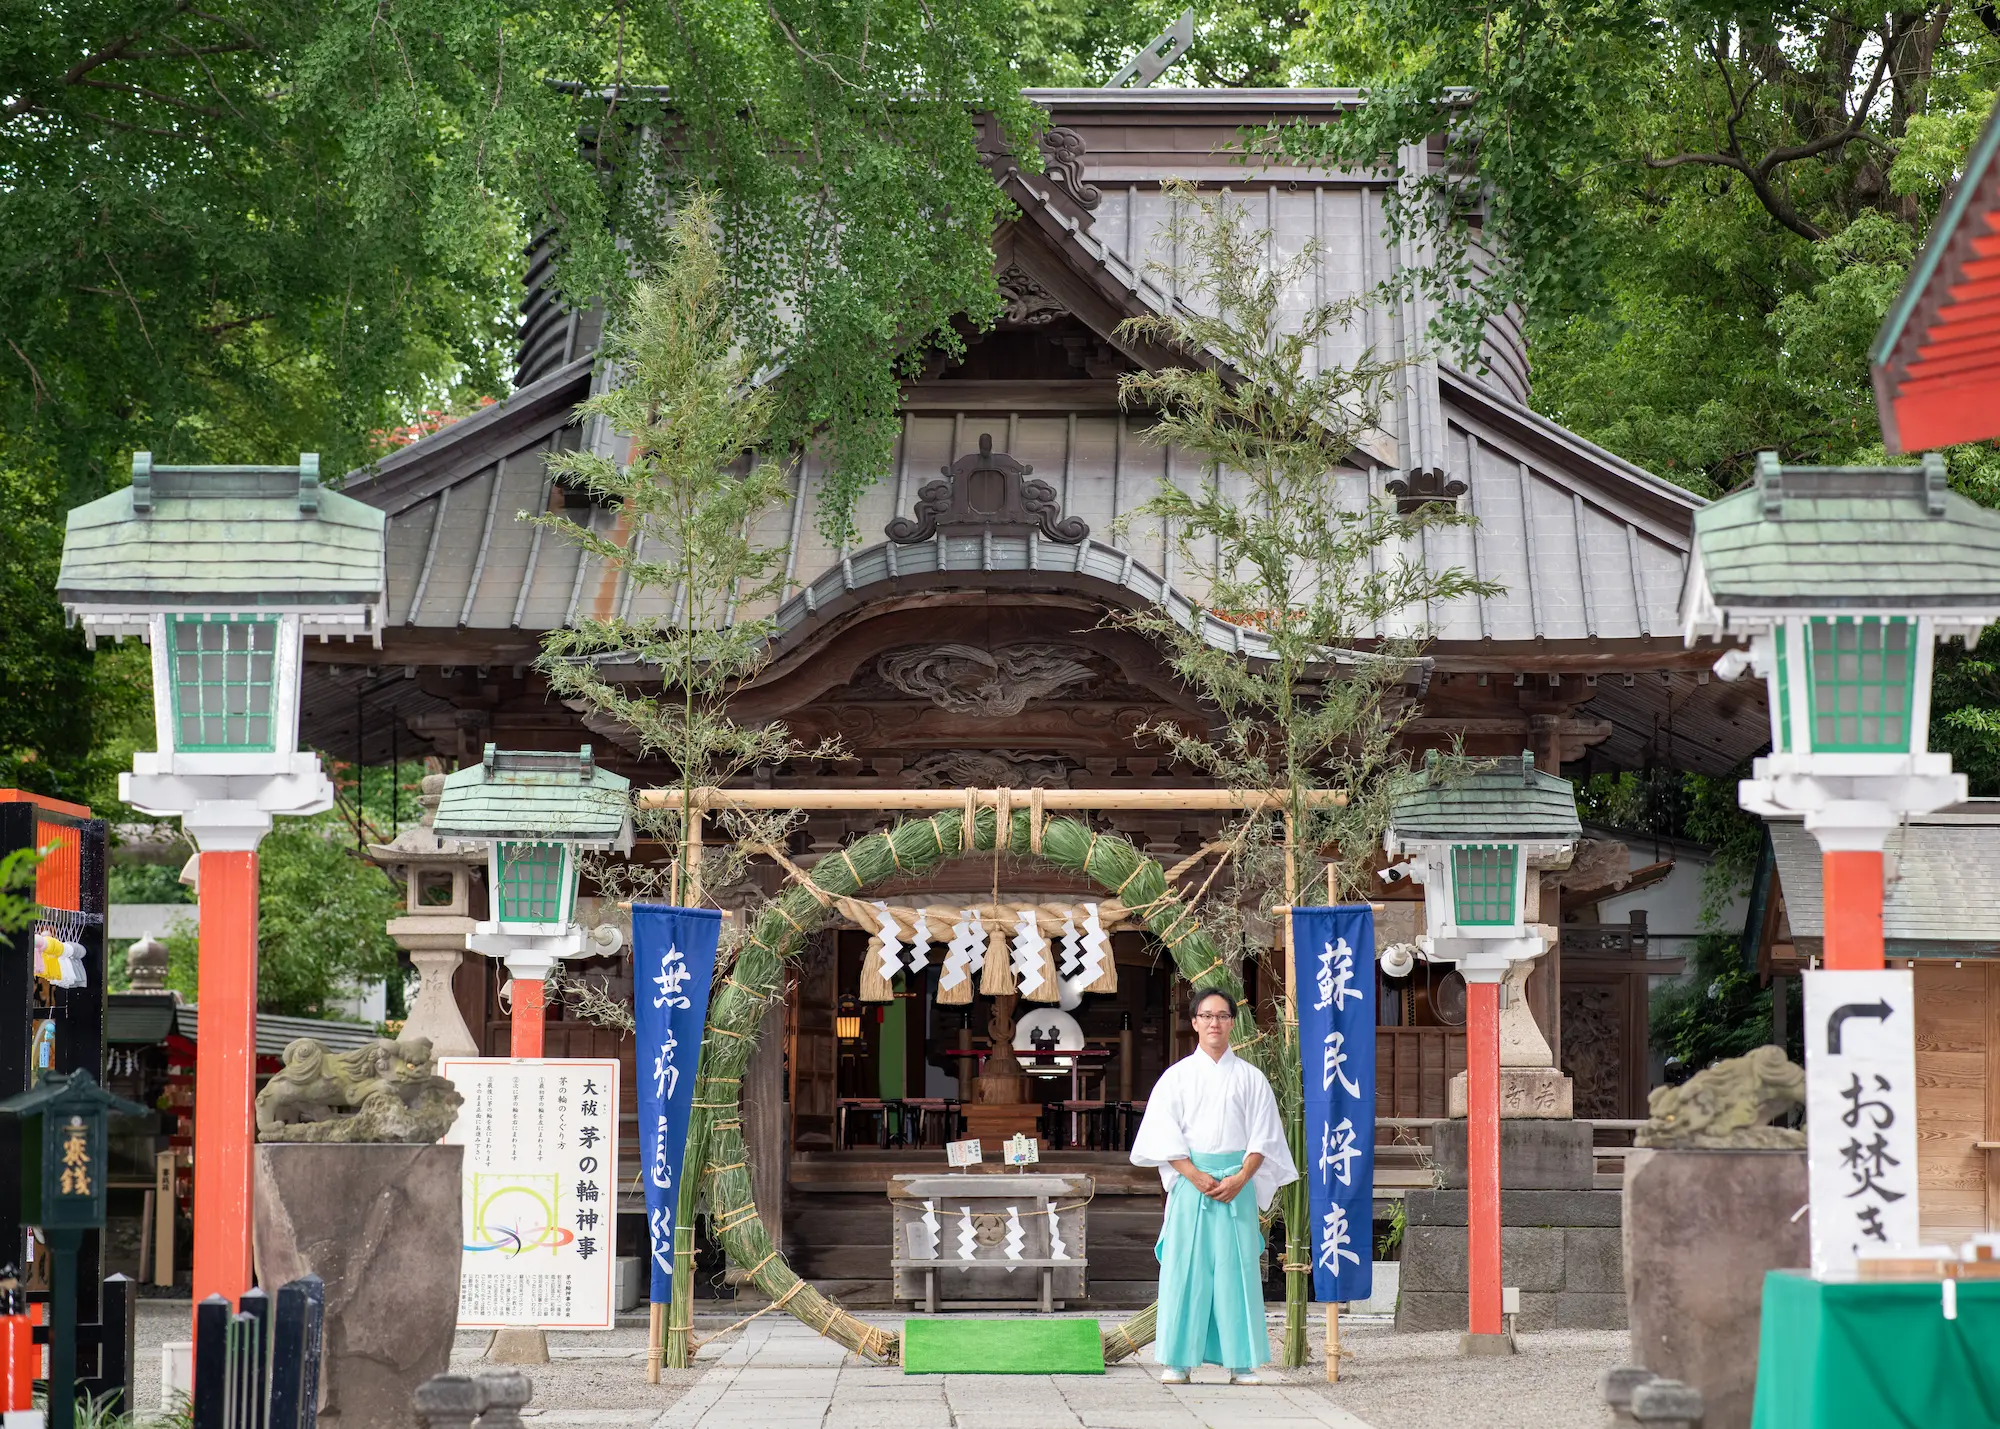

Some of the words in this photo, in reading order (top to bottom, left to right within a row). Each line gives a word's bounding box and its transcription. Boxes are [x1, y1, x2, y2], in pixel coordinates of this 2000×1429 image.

[557, 1076, 568, 1150] 茅の輪のくぐり方
[1313, 937, 1363, 1278] 蘇民将来
